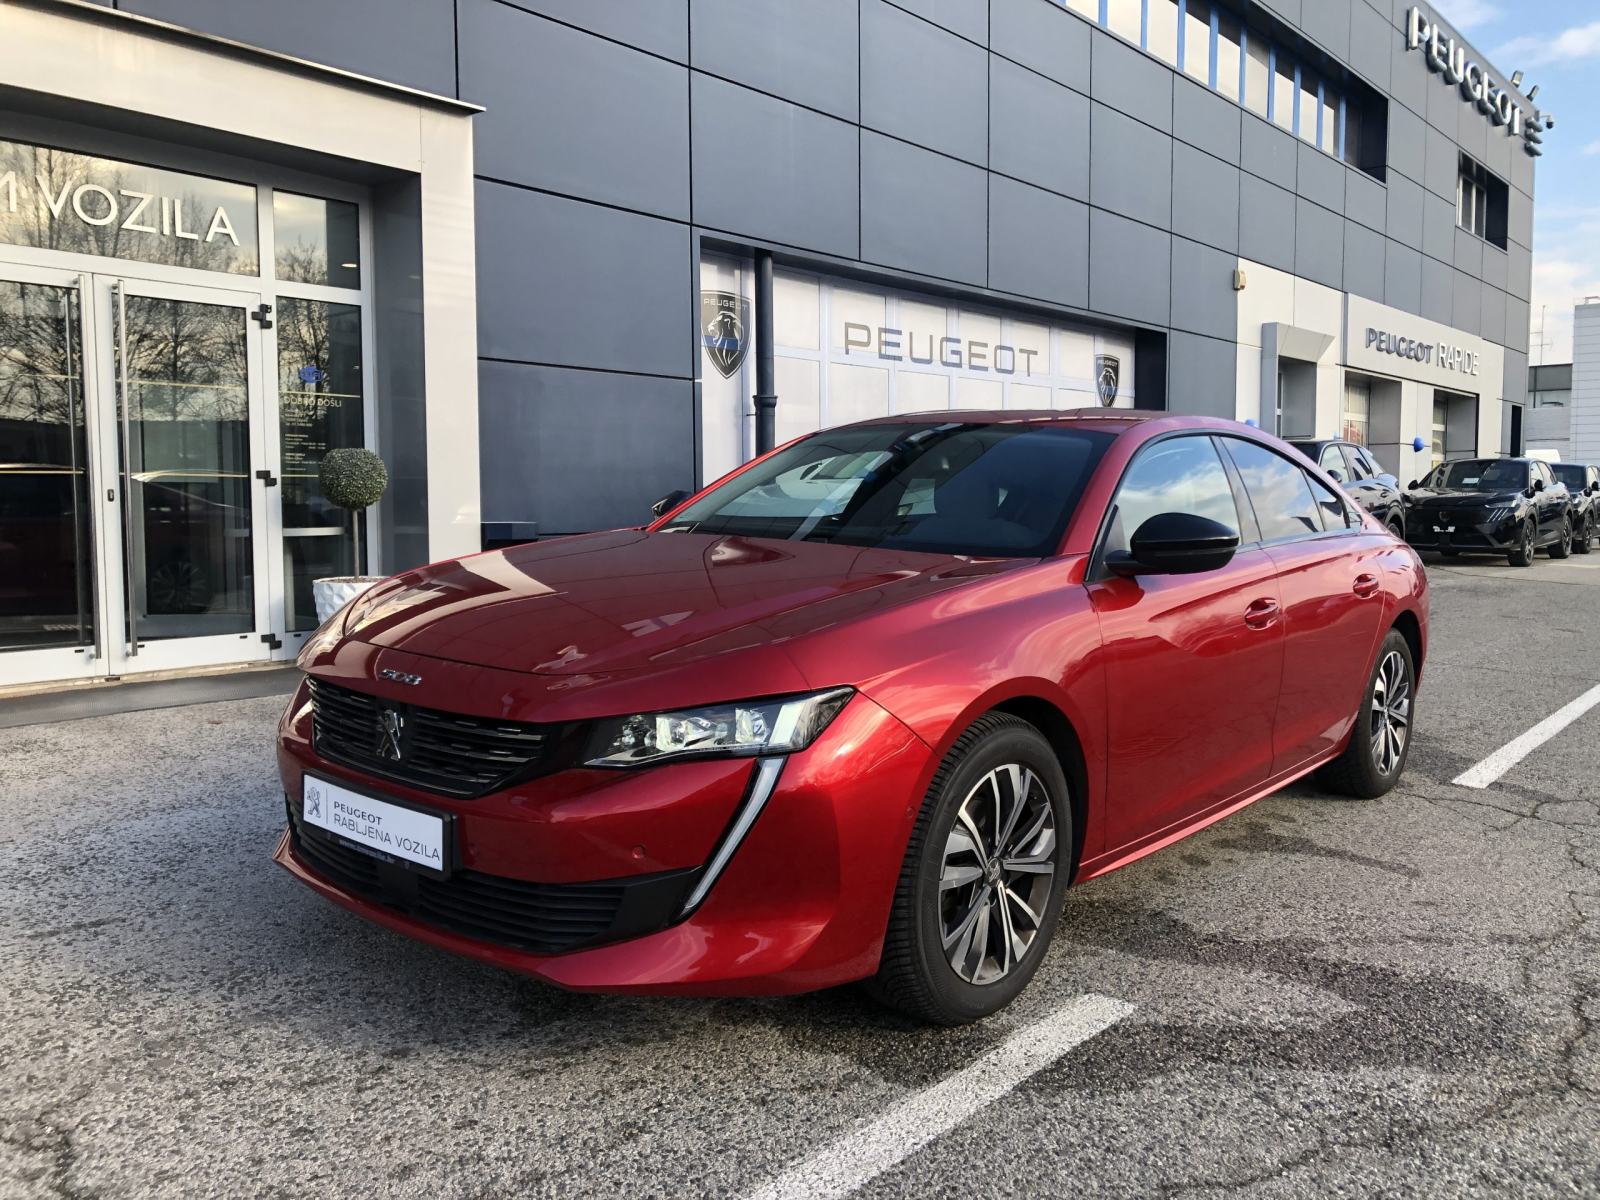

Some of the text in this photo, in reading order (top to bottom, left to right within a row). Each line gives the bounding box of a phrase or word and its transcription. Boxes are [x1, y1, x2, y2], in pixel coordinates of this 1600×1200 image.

[1406, 6, 1523, 136] PEUGEOT
[36, 175, 240, 246] VOZILA
[844, 321, 1038, 377] PEUGEOT
[1365, 327, 1480, 376] PEUGEOT RAPIDE
[334, 801, 382, 825] PEUGEOT
[334, 813, 392, 845] RABLJENA
[395, 834, 440, 861] VOZILA
